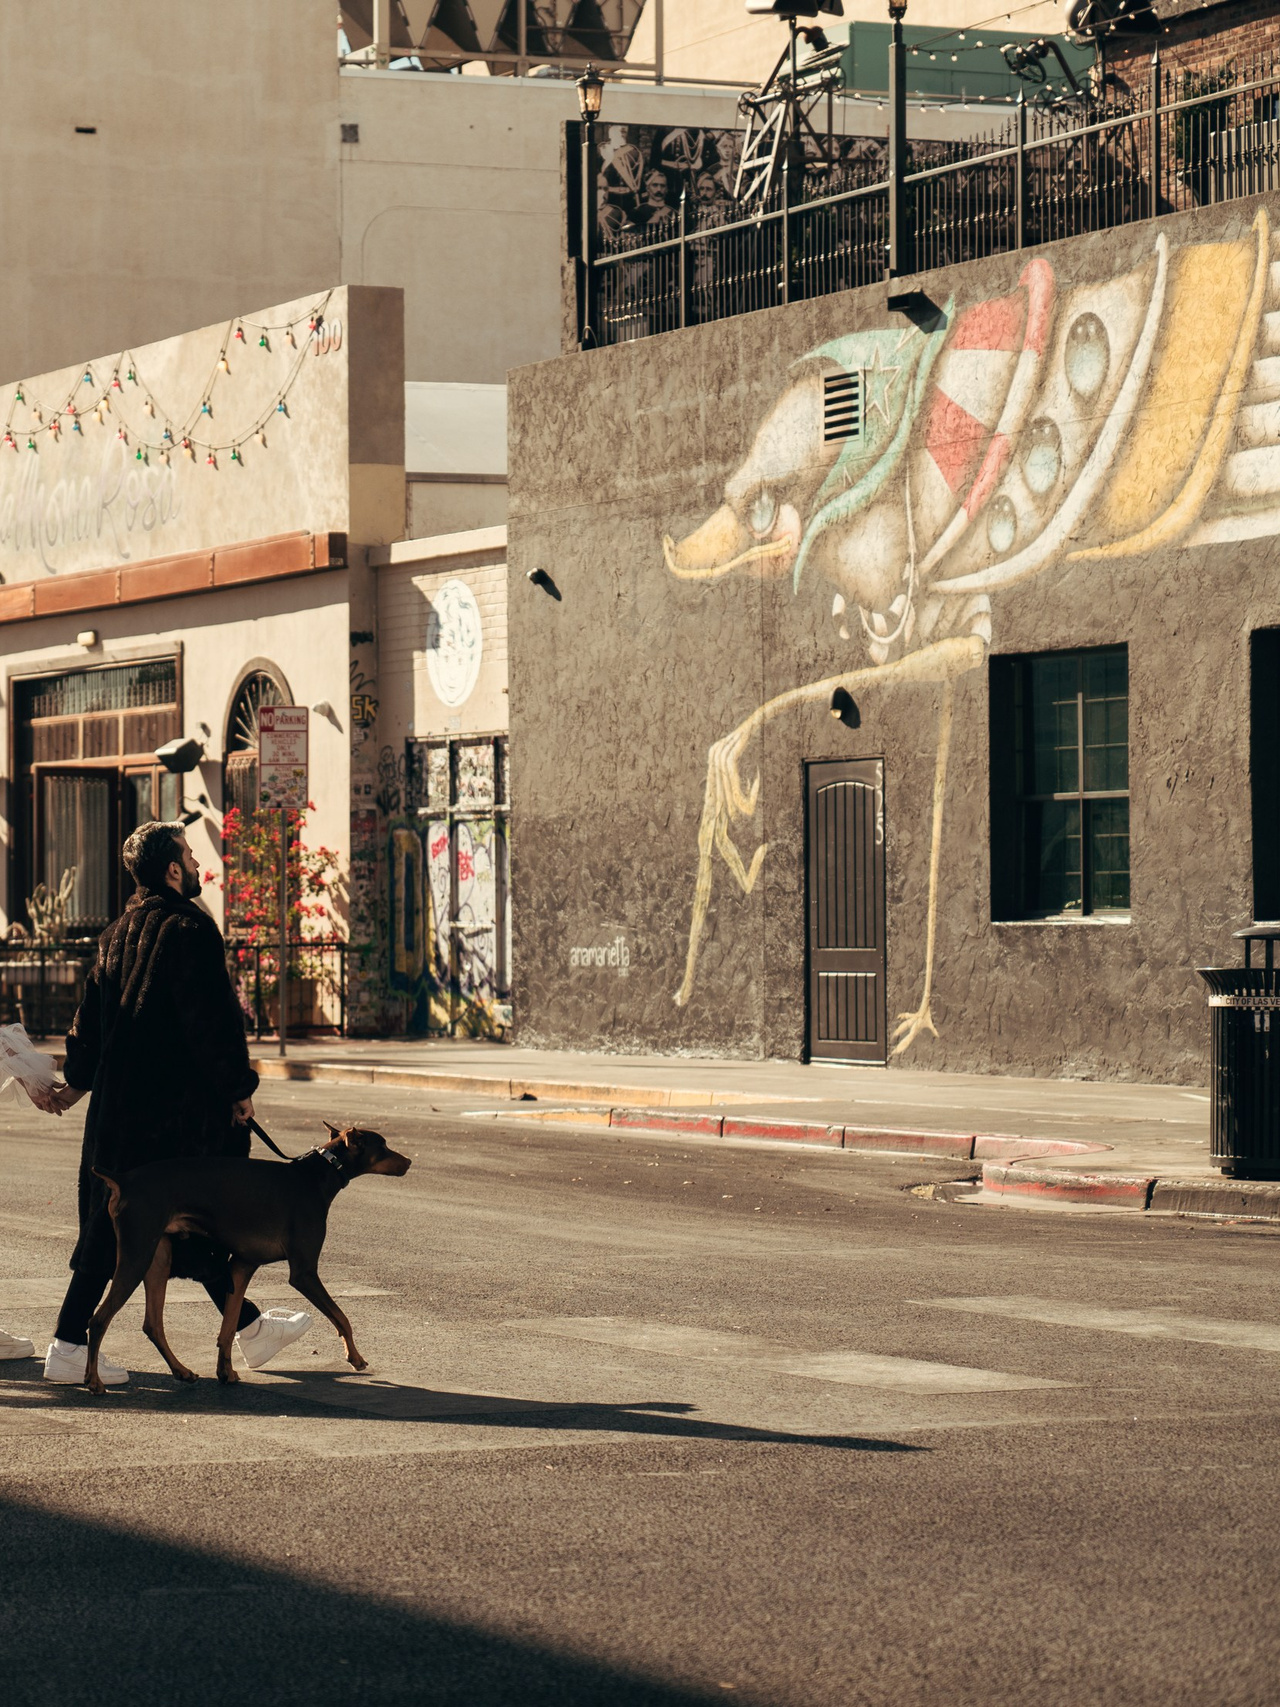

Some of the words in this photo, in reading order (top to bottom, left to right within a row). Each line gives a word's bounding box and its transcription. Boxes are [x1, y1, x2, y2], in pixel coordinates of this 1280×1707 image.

[312, 318, 343, 357] 100
[94, 436, 184, 559] Rosa
[261, 712, 274, 727] NO
[275, 715, 306, 725] PARKING
[1241, 997, 1251, 1005] OF
[1253, 997, 1269, 1005] LAS
